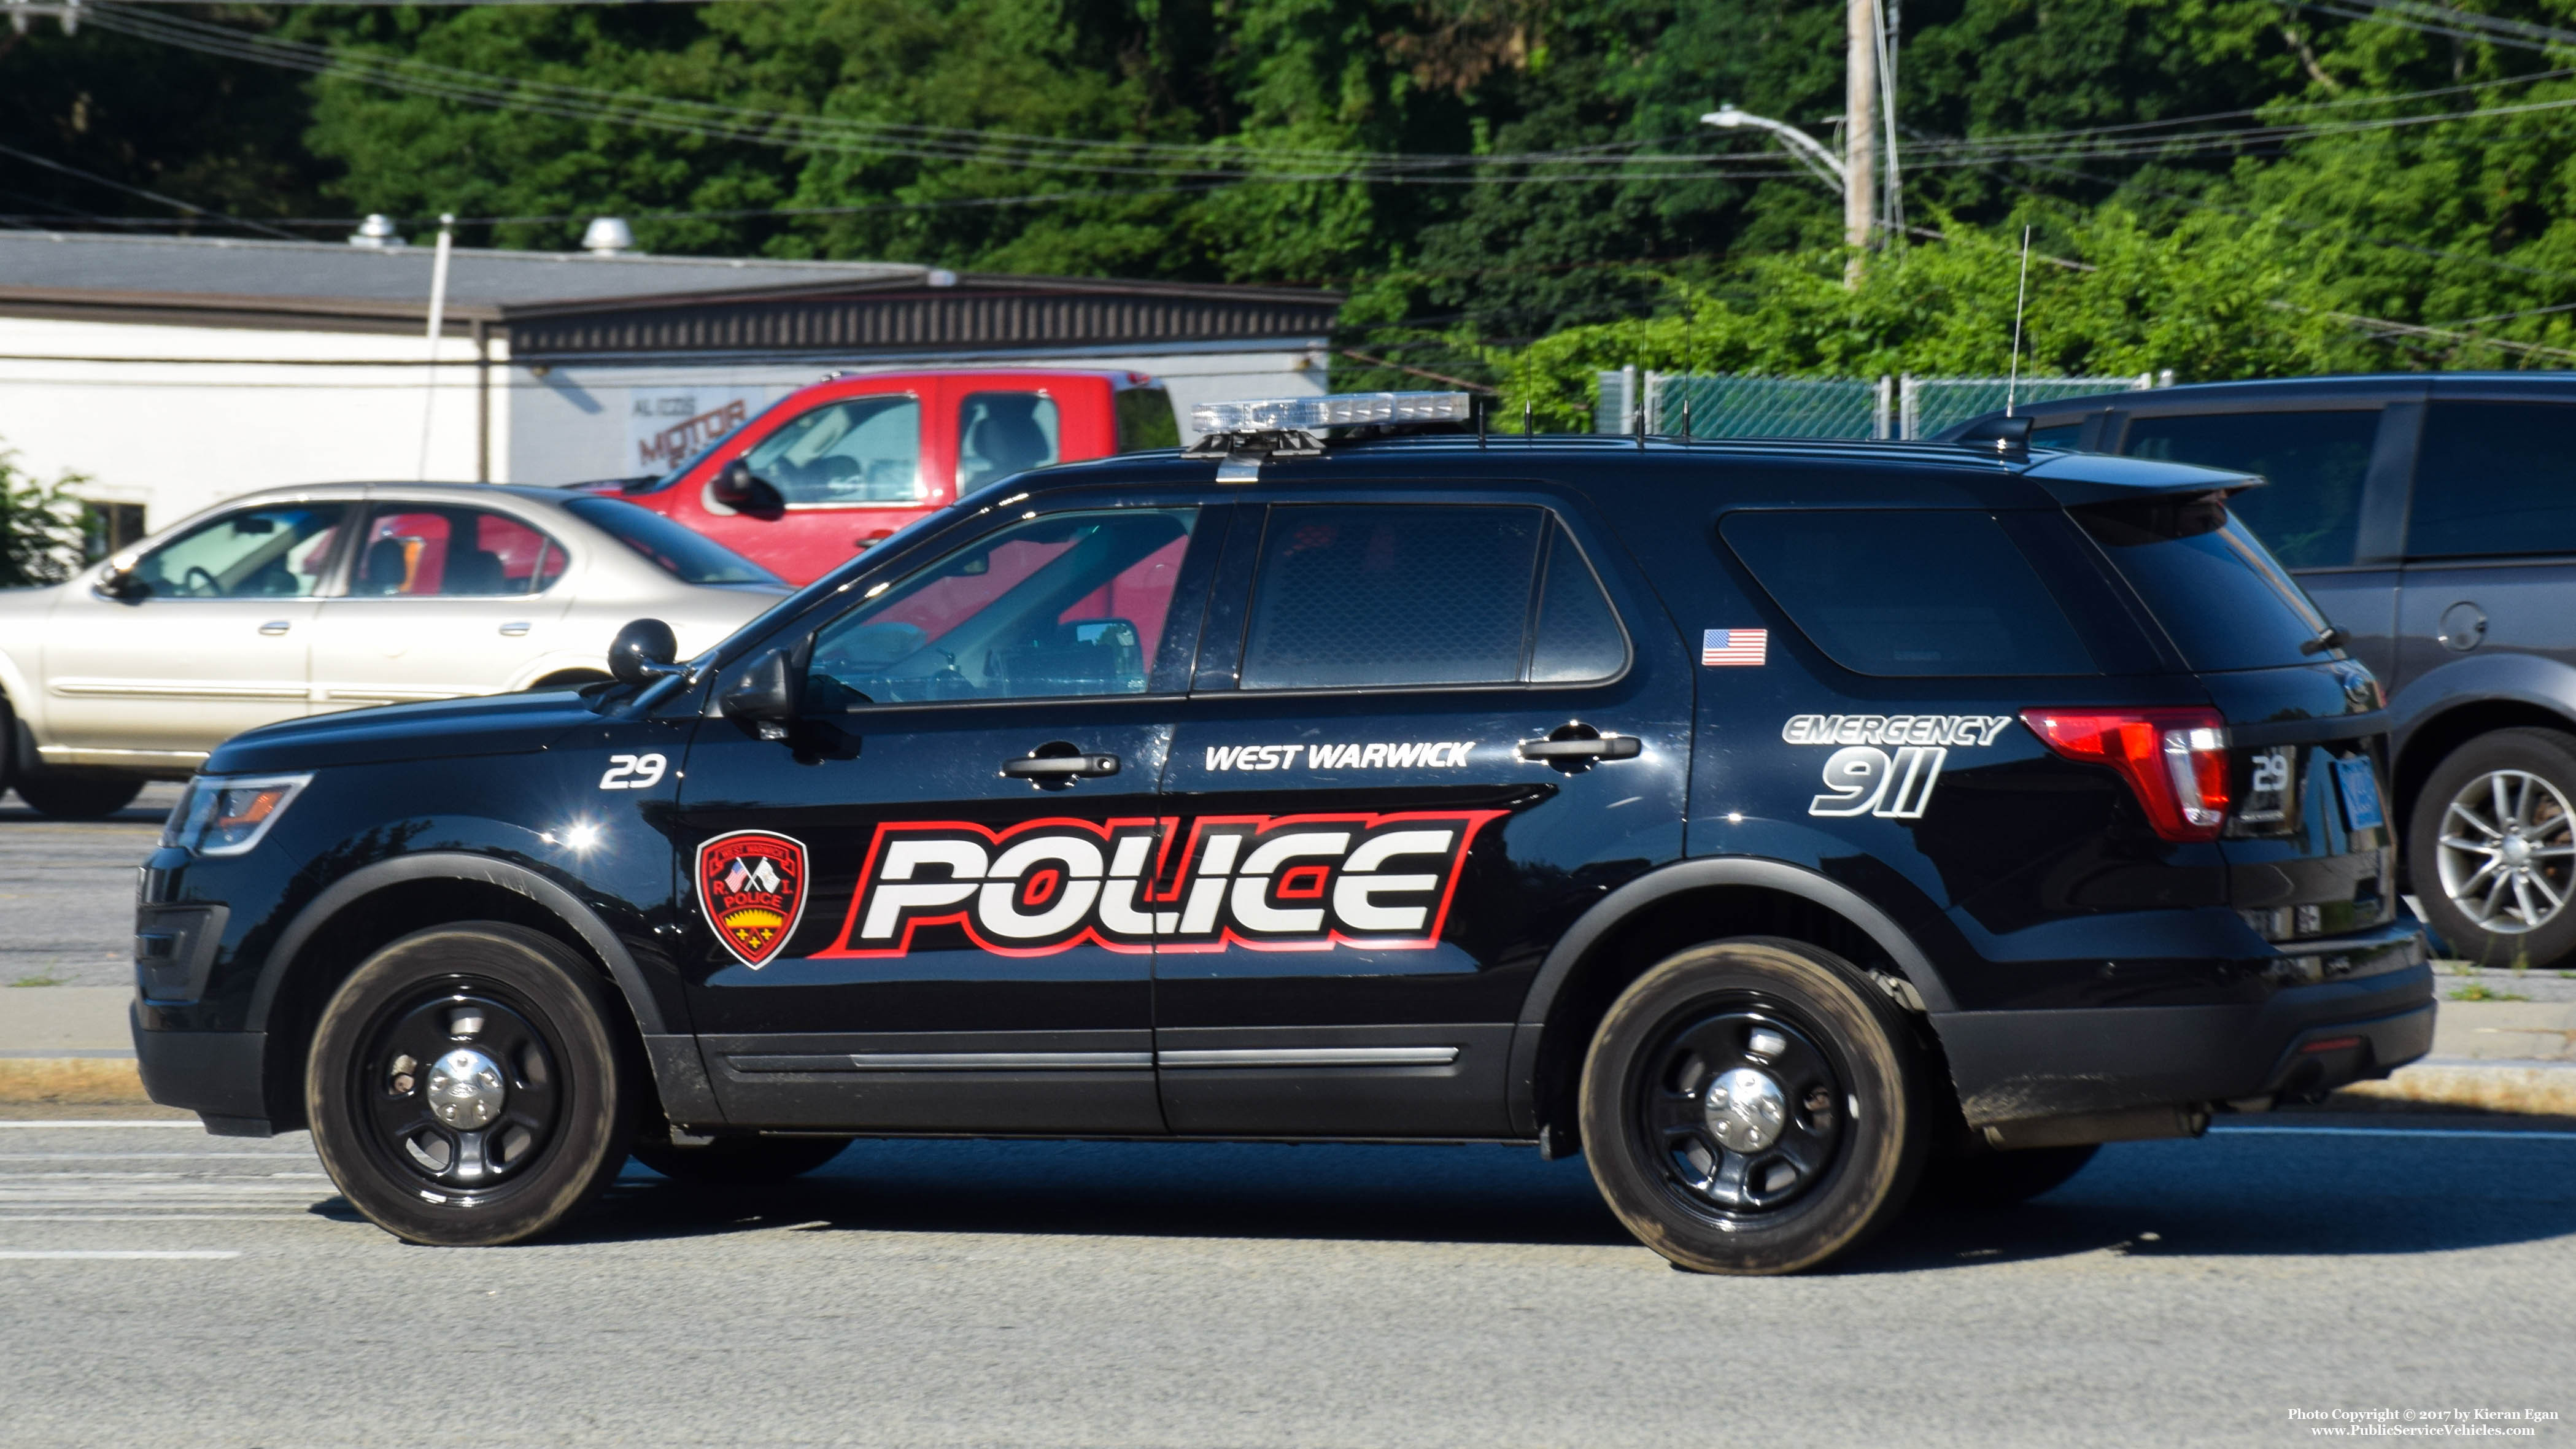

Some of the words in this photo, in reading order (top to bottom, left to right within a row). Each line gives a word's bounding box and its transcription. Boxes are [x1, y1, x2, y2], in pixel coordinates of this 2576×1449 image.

[638, 399, 746, 466] MOTOR
[1782, 714, 2013, 746] EMERGENCY
[598, 752, 668, 790] 29
[1206, 744, 1304, 771] WEST
[1308, 740, 1476, 770] WARWICK
[2251, 754, 2289, 792] 29
[1808, 746, 1948, 819] 911
[724, 892, 783, 908] POLICE
[861, 829, 1453, 940] POLICE
